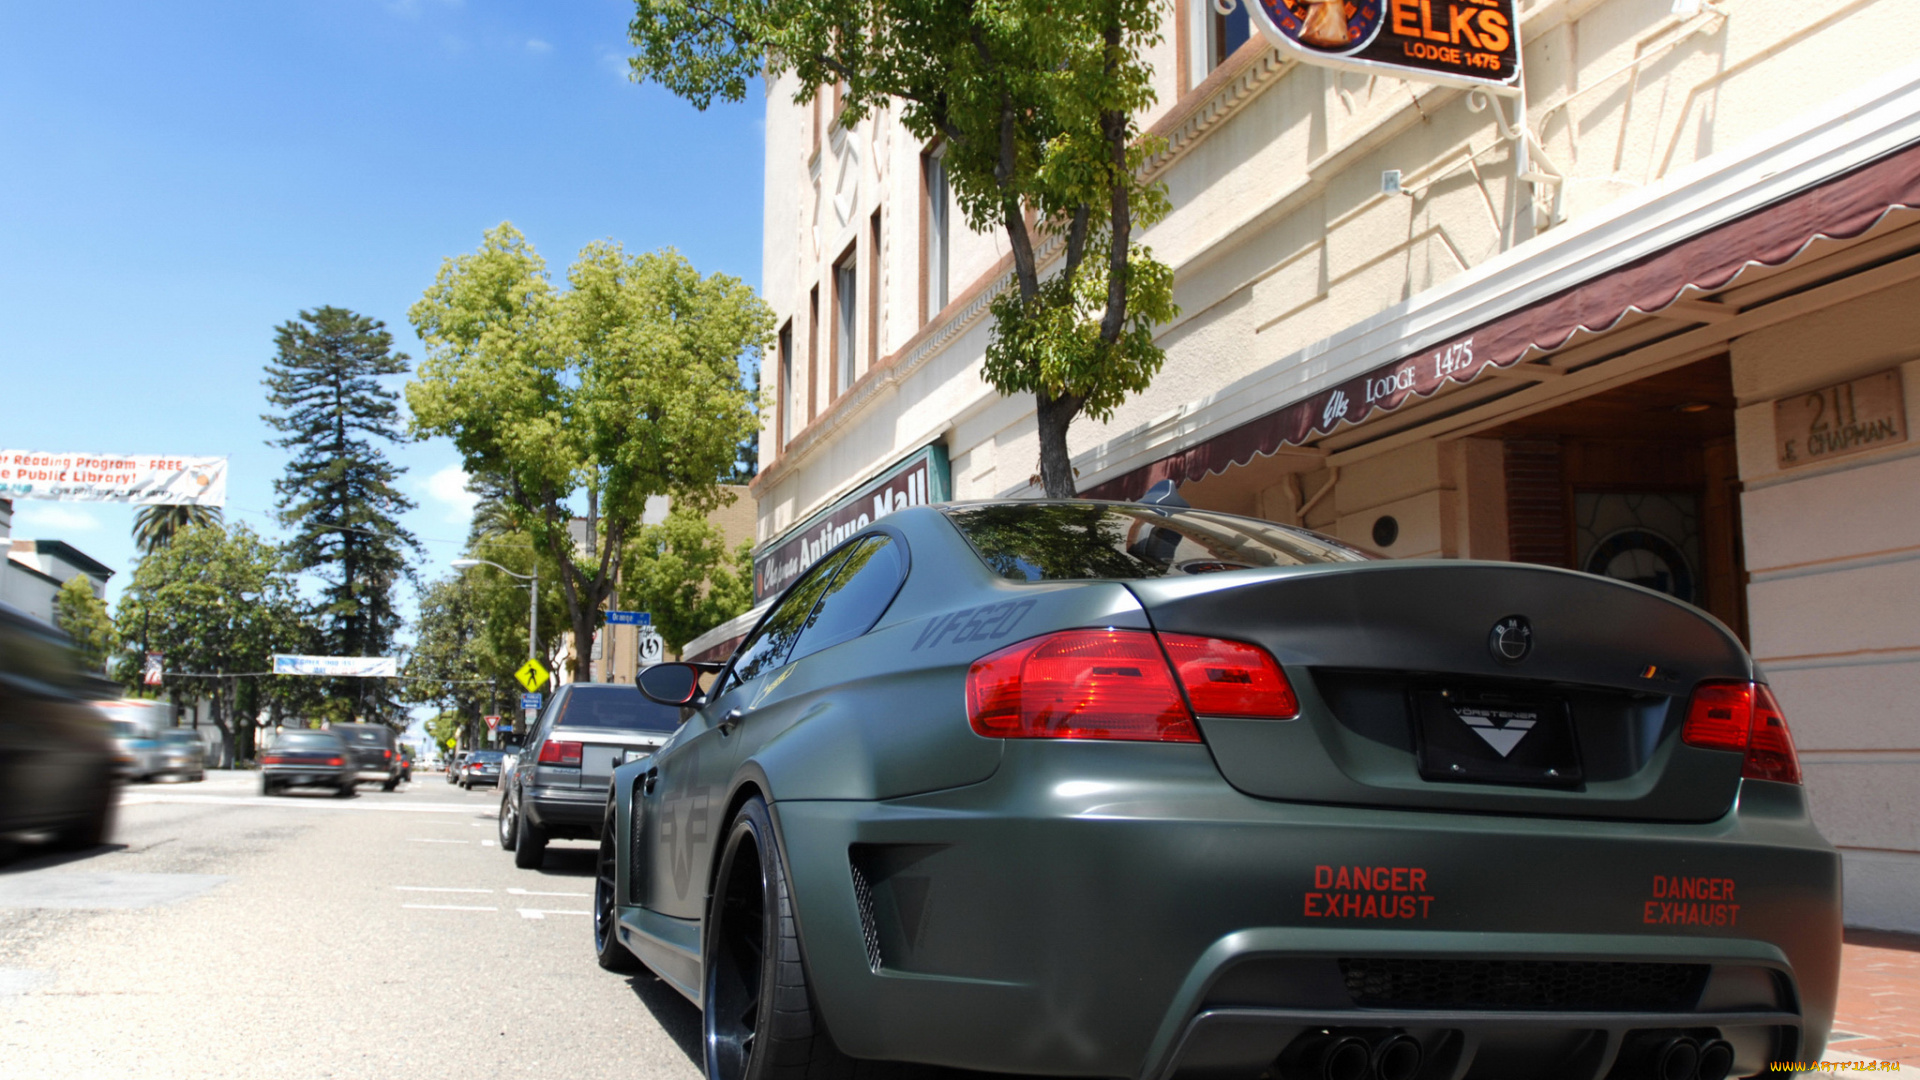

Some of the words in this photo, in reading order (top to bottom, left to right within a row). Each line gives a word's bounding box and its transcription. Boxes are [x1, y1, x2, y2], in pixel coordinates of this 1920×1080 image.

[1391, 0, 1510, 52] ELKS
[1404, 42, 1461, 64] LODGE
[1464, 52, 1501, 70] 1475
[1323, 390, 1349, 428] Elks
[1434, 337, 1473, 379] 1475
[1806, 381, 1857, 432] 211
[14, 454, 71, 470] Reading
[76, 458, 136, 471] Program
[149, 460, 183, 470] FREE
[17, 468, 67, 482] Public
[73, 471, 136, 485] Library!
[873, 467, 926, 521] Mall
[911, 599, 1038, 652] VF620
[1314, 864, 1427, 892] DANGER
[1653, 875, 1735, 901] DANGER
[1304, 892, 1435, 919] EXHAUST
[1643, 901, 1740, 926] EXHAUST
